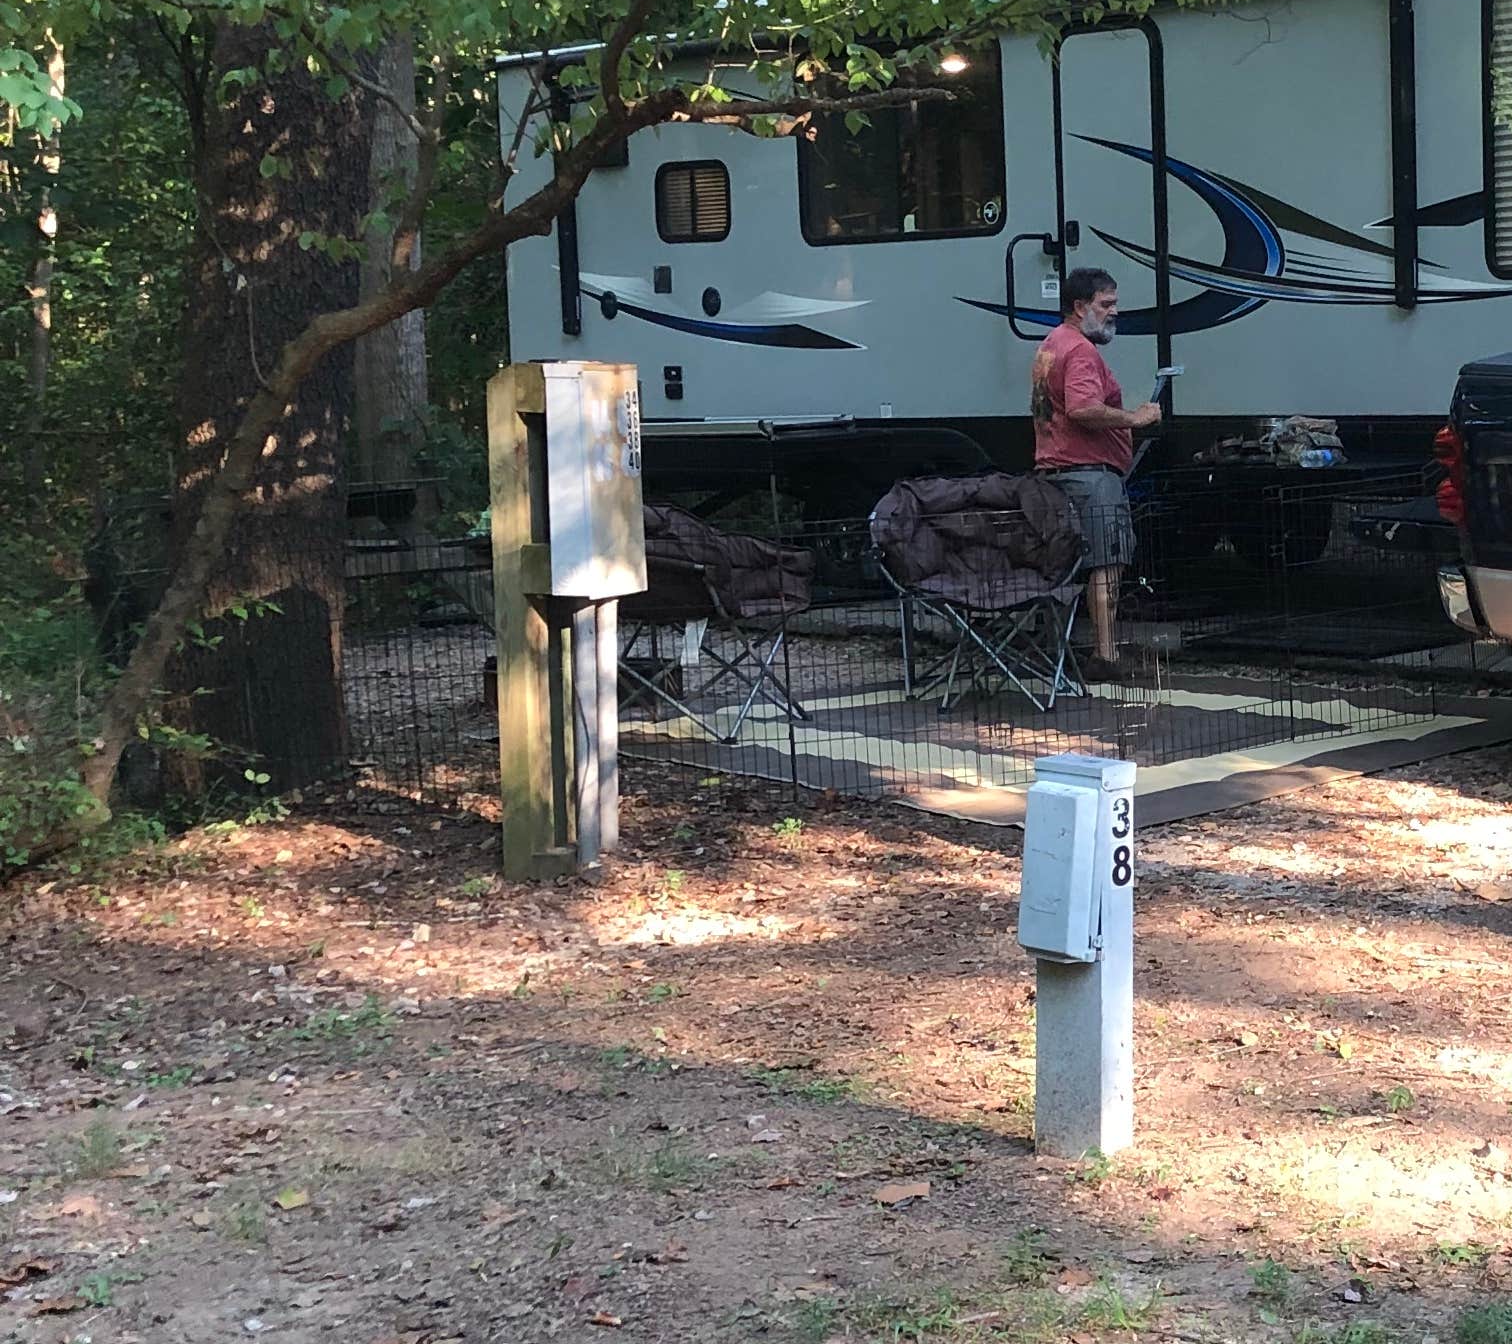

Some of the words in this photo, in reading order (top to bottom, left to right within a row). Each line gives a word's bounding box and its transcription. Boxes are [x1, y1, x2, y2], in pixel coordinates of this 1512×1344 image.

[625, 390, 637, 409] 34
[627, 410, 638, 429] 36
[627, 431, 639, 450] 38
[628, 451, 640, 470] 40
[1111, 797, 1132, 887] 38
